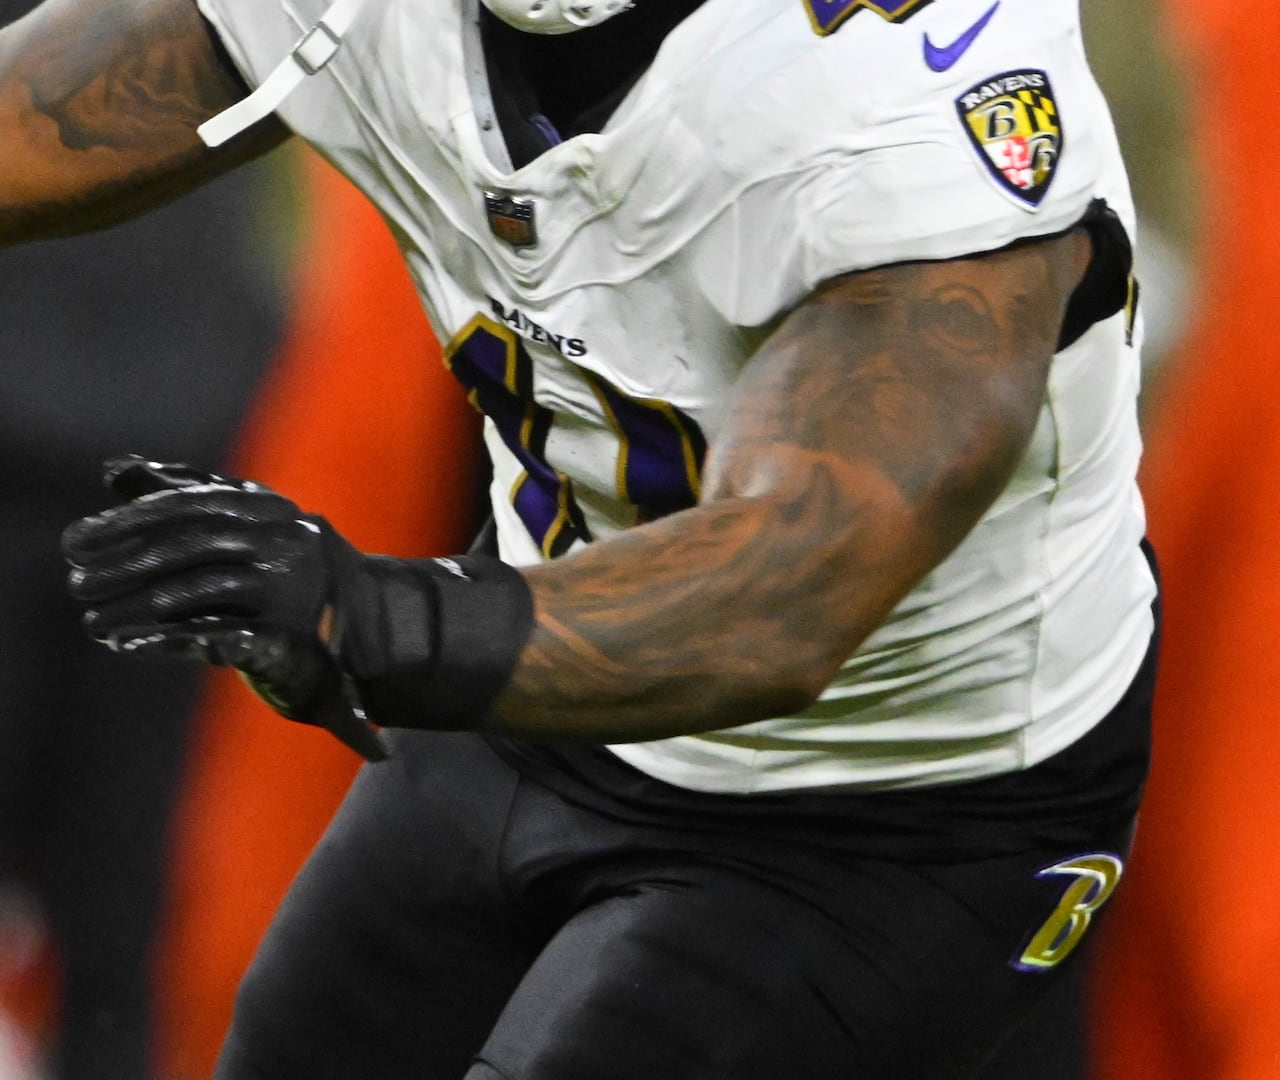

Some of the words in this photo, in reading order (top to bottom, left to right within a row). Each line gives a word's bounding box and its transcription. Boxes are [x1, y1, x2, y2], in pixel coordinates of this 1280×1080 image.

[960, 74, 1044, 110] RAVENS
[485, 294, 588, 357] RAVENS
[1008, 850, 1124, 971] B
